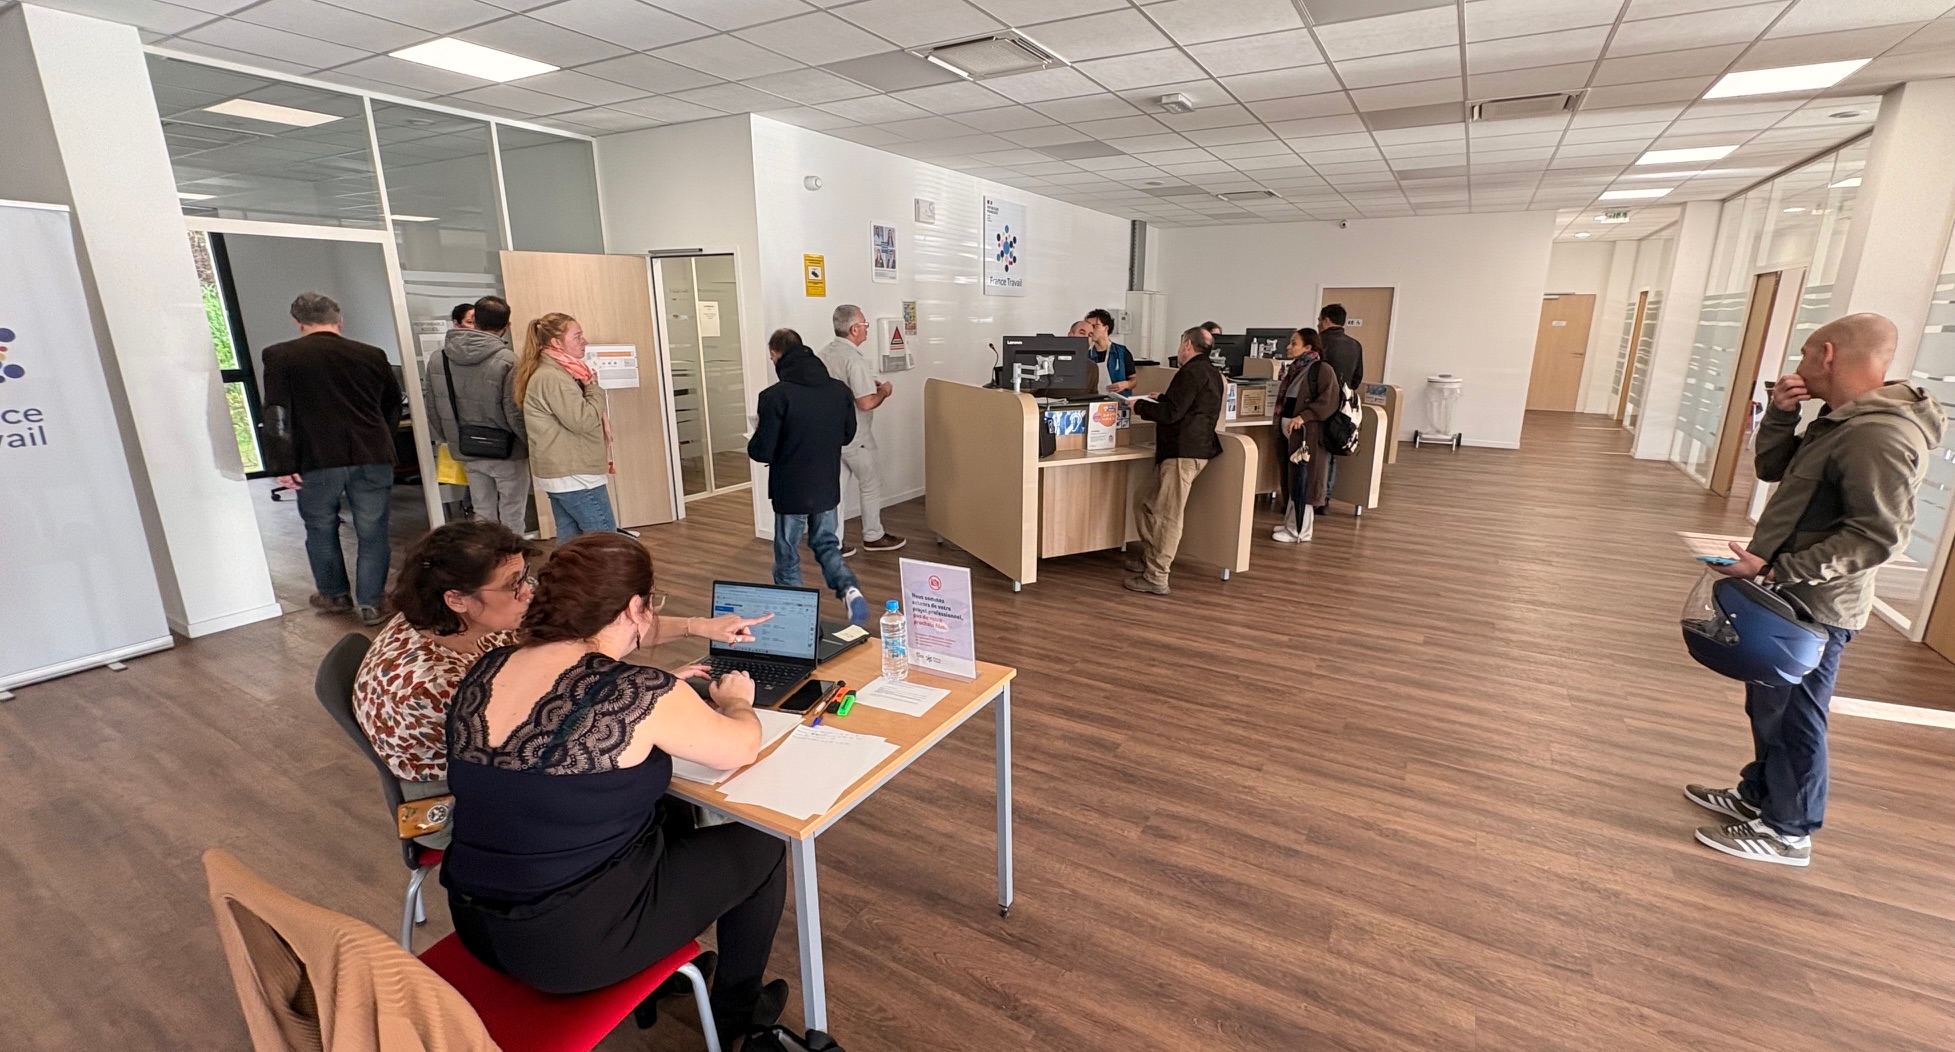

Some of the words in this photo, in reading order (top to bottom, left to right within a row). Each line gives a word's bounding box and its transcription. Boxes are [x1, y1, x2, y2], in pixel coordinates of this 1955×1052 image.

[990, 276, 1006, 286] France
[1007, 277, 1022, 286] Travail
[911, 592, 923, 600] Nous
[912, 600, 930, 608] acteurs
[912, 607, 927, 615] projet
[913, 620, 934, 628] prochain
